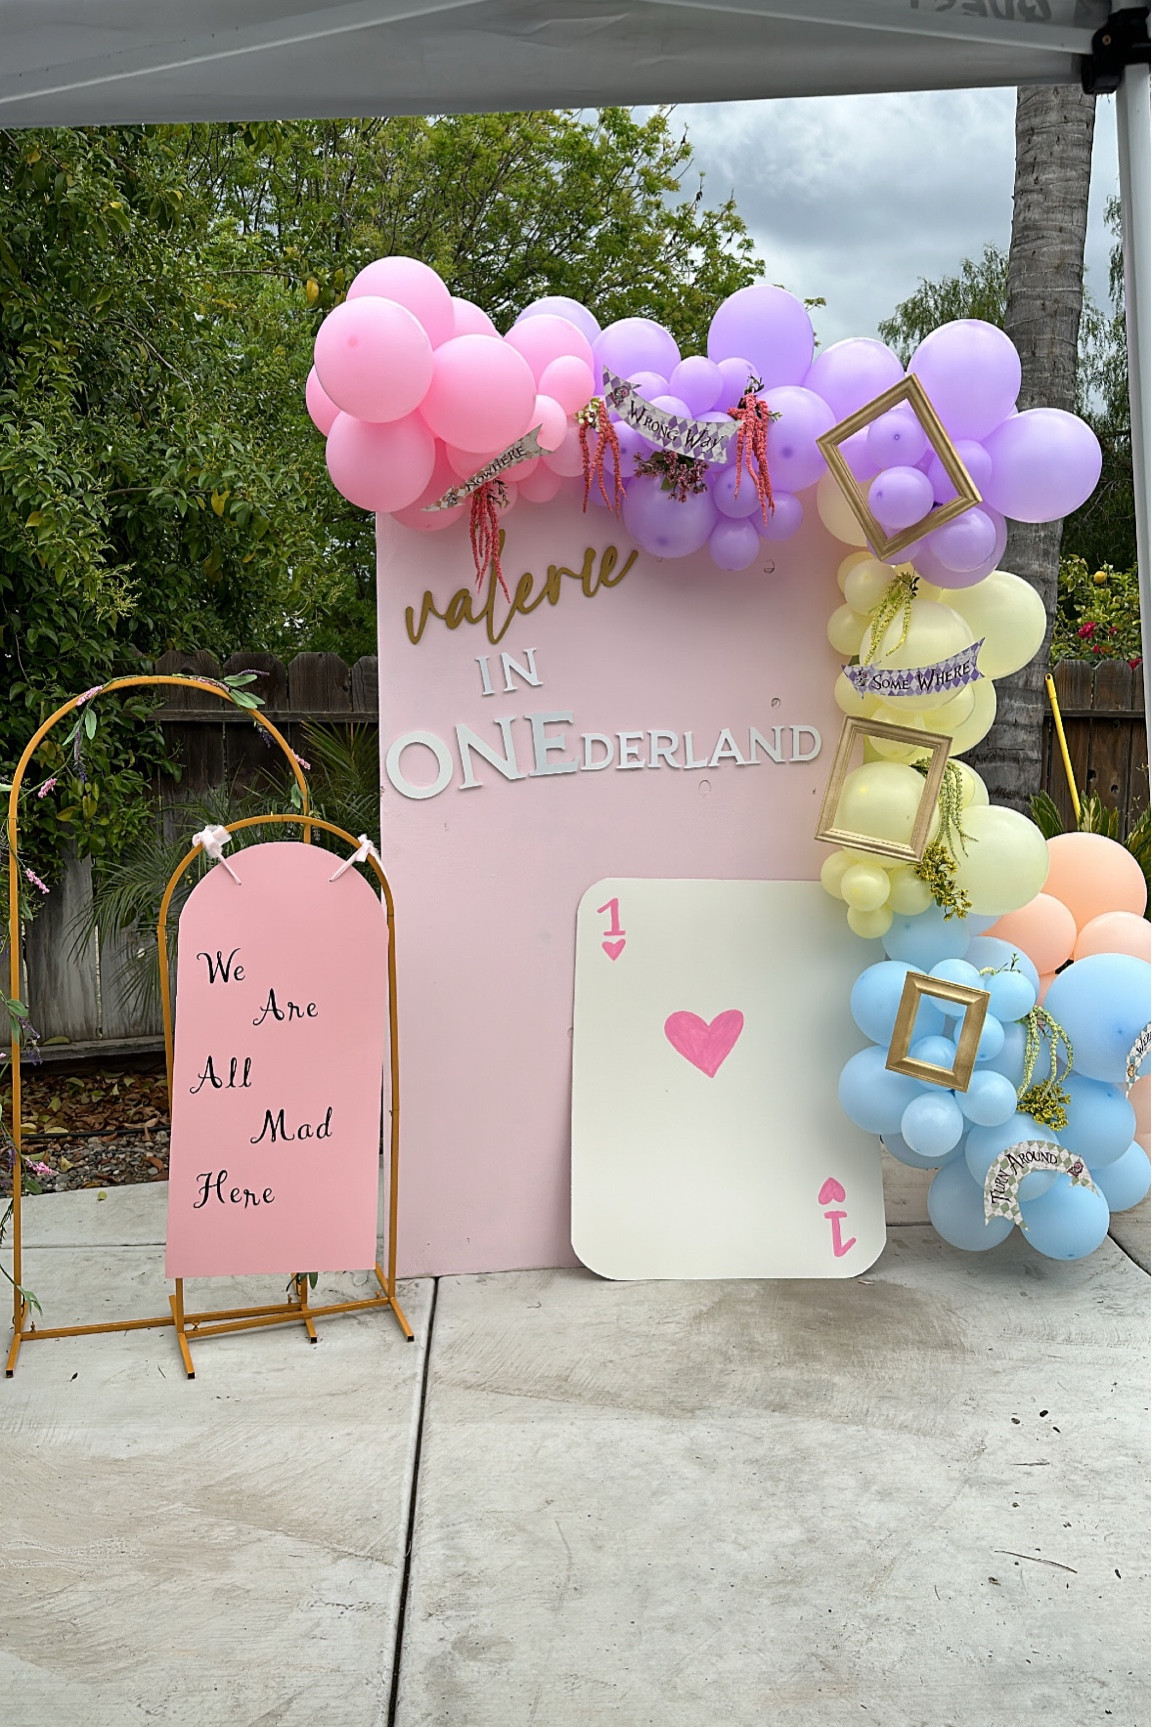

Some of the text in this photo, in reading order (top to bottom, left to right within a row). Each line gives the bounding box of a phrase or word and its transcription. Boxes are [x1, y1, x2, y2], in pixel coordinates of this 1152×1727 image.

[405, 528, 639, 646] valerie
[474, 647, 544, 696] IN
[596, 897, 627, 937] 1
[196, 947, 247, 985] We
[252, 987, 320, 1027] Are
[189, 1055, 253, 1095] All
[249, 1105, 334, 1145] Mad
[192, 1169, 276, 1210] Here
[823, 1210, 857, 1258] 1
